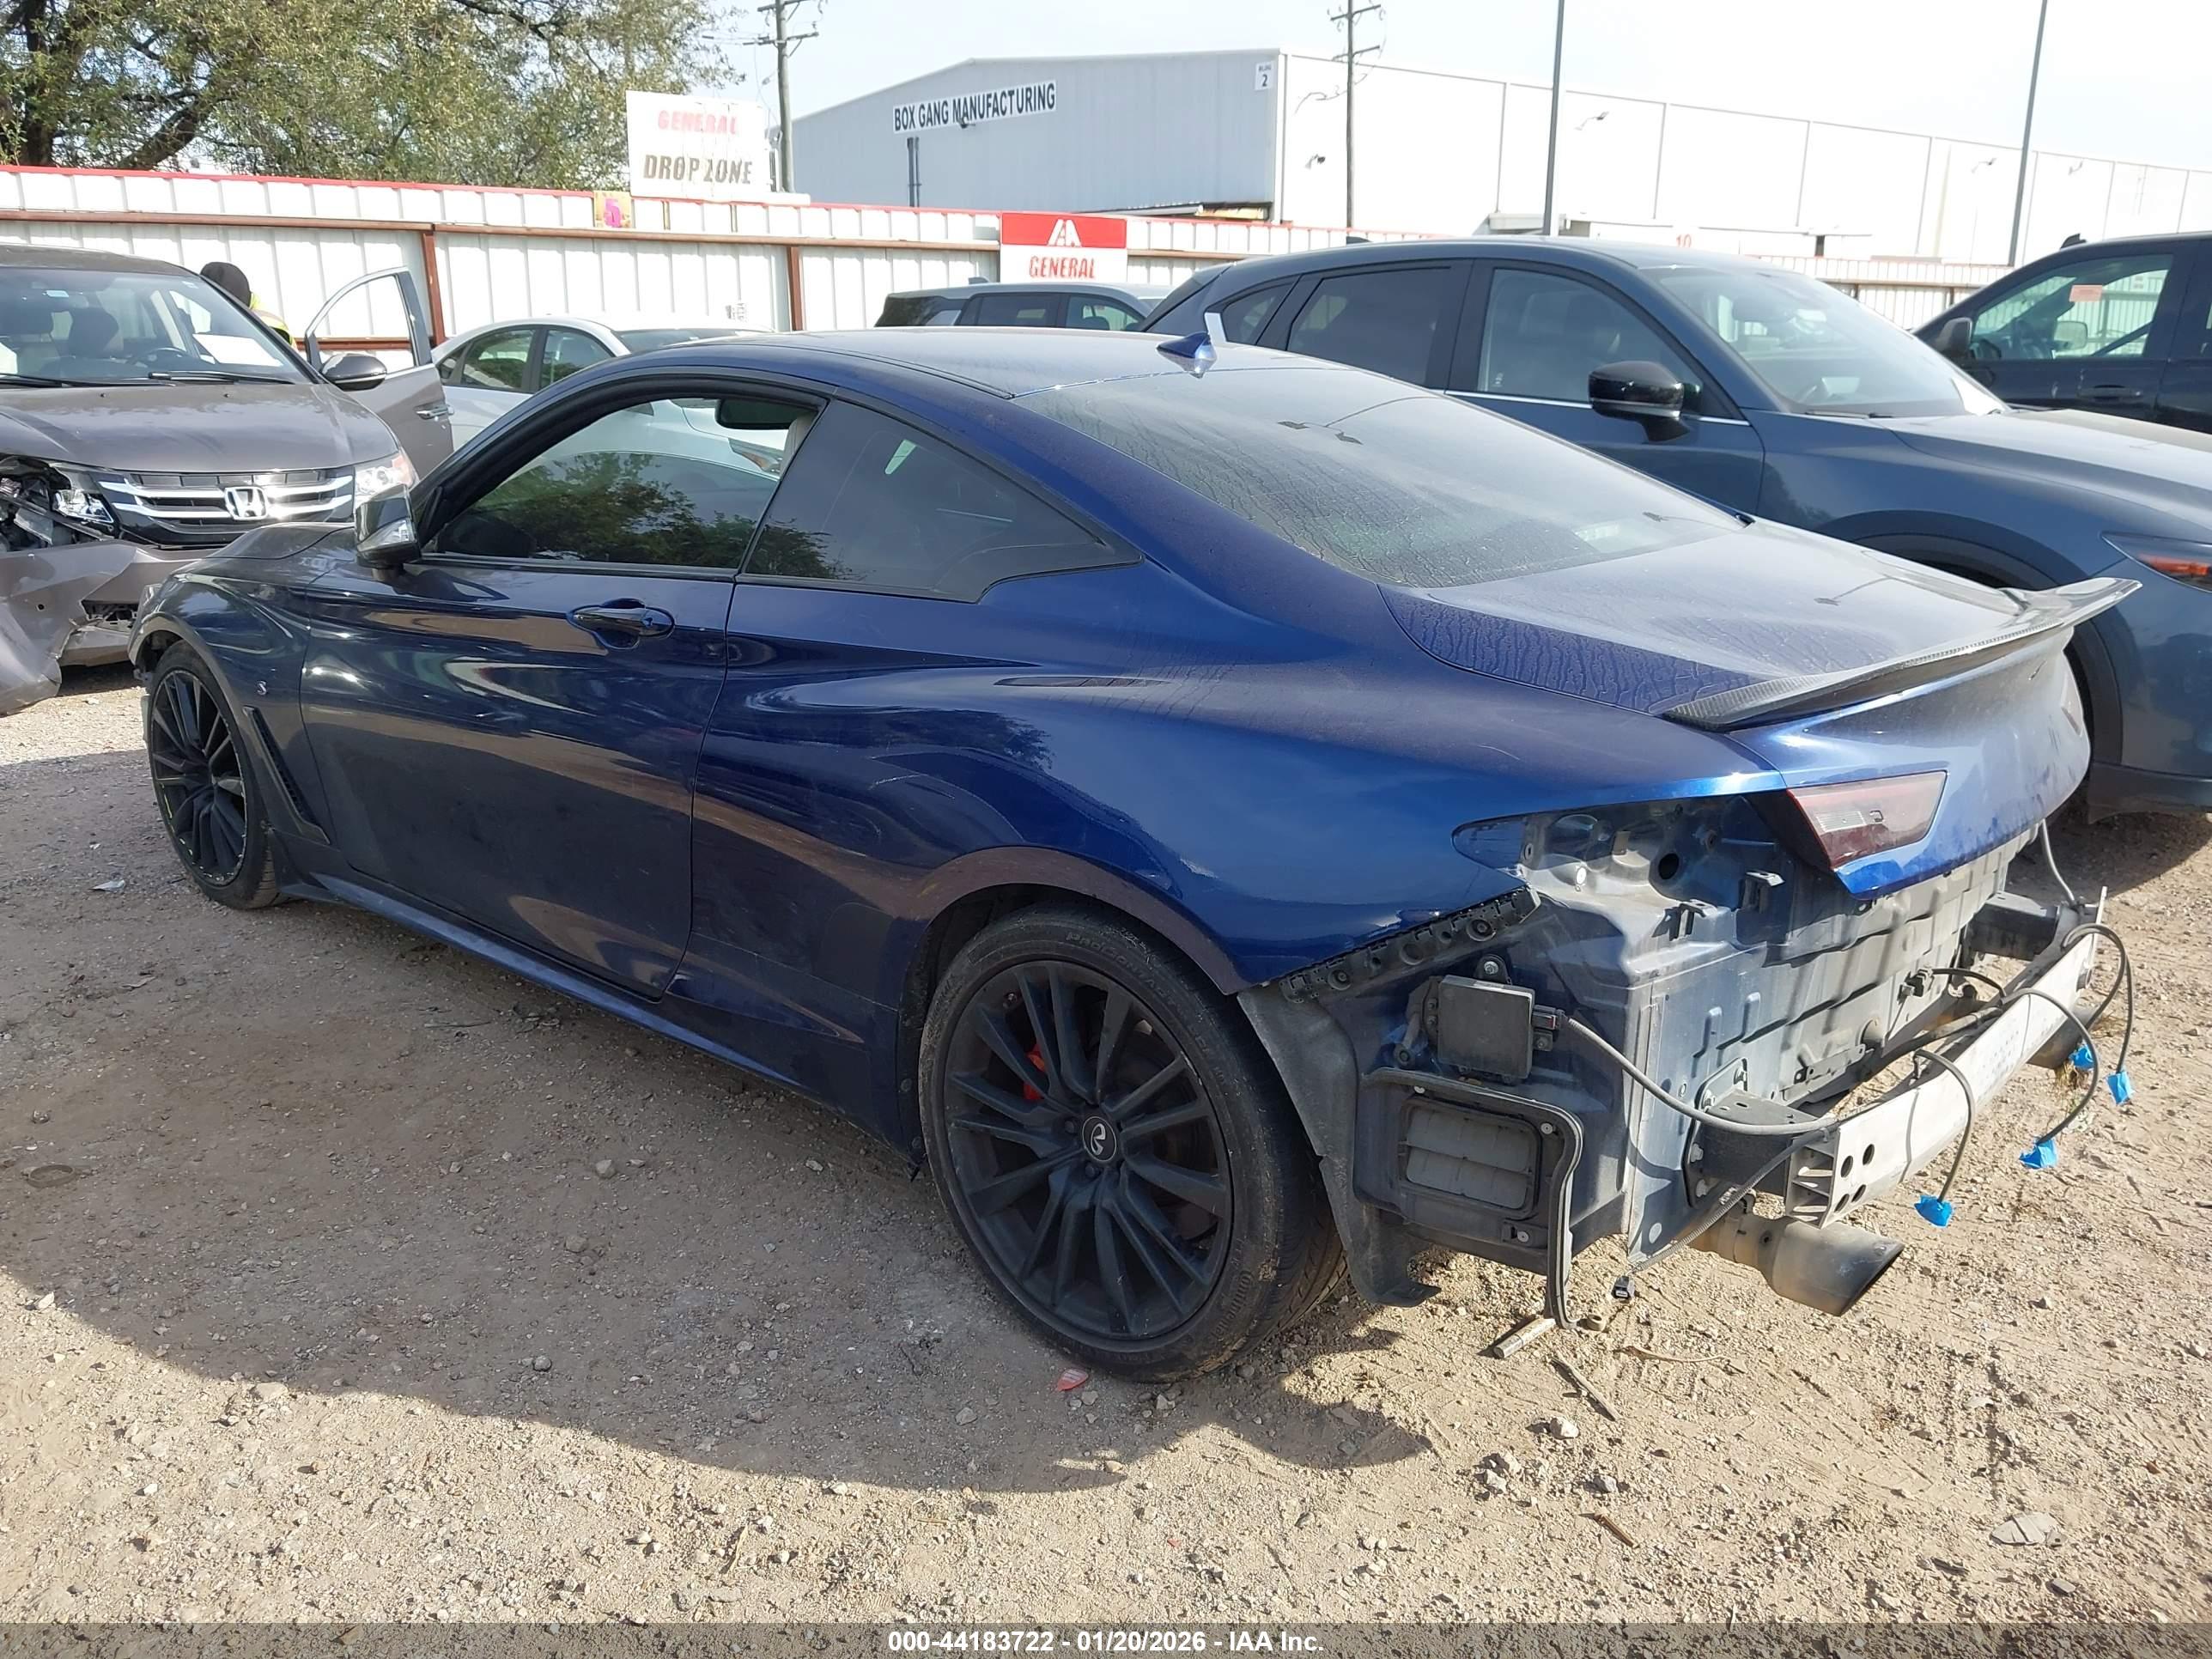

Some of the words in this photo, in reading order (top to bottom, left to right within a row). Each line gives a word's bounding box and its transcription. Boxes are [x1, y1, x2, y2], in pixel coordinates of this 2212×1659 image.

[1262, 74, 1268, 87] 2
[894, 105, 915, 131] BOX
[918, 100, 949, 128] GANG
[952, 83, 1055, 123] MANUFACTURING
[658, 109, 739, 135] GENERAL
[643, 154, 701, 182] DROP
[703, 158, 753, 185] ZONE
[1029, 255, 1096, 279] GENERAL
[257, 680, 267, 696] S
